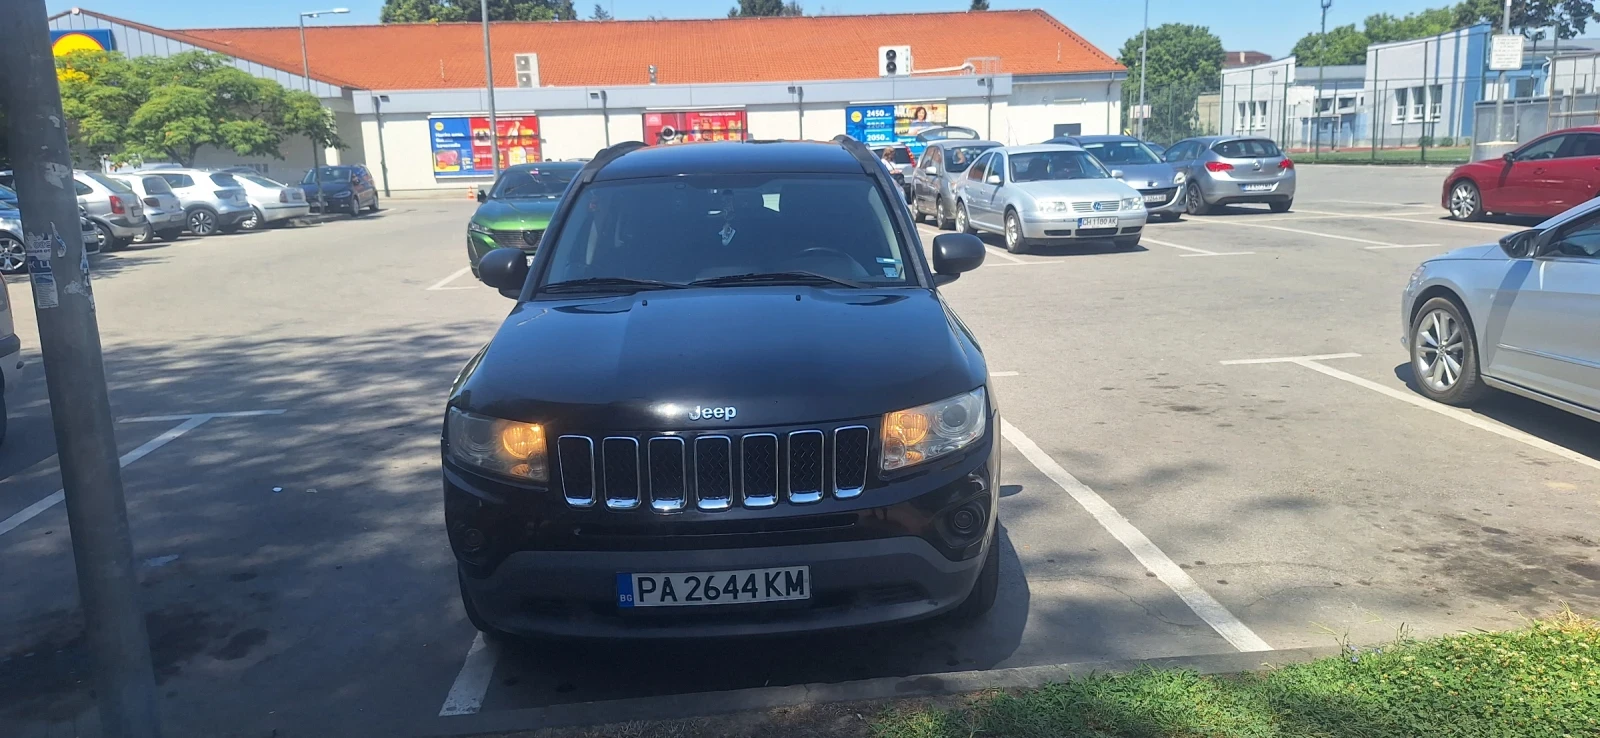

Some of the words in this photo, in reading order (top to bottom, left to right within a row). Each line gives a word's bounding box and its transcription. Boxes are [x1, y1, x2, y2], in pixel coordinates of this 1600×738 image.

[867, 109, 885, 117] 2450
[688, 405, 737, 421] Jeep
[637, 576, 678, 603] PA
[684, 573, 758, 602] 2644
[765, 570, 805, 598] KM
[620, 594, 633, 602] BG
